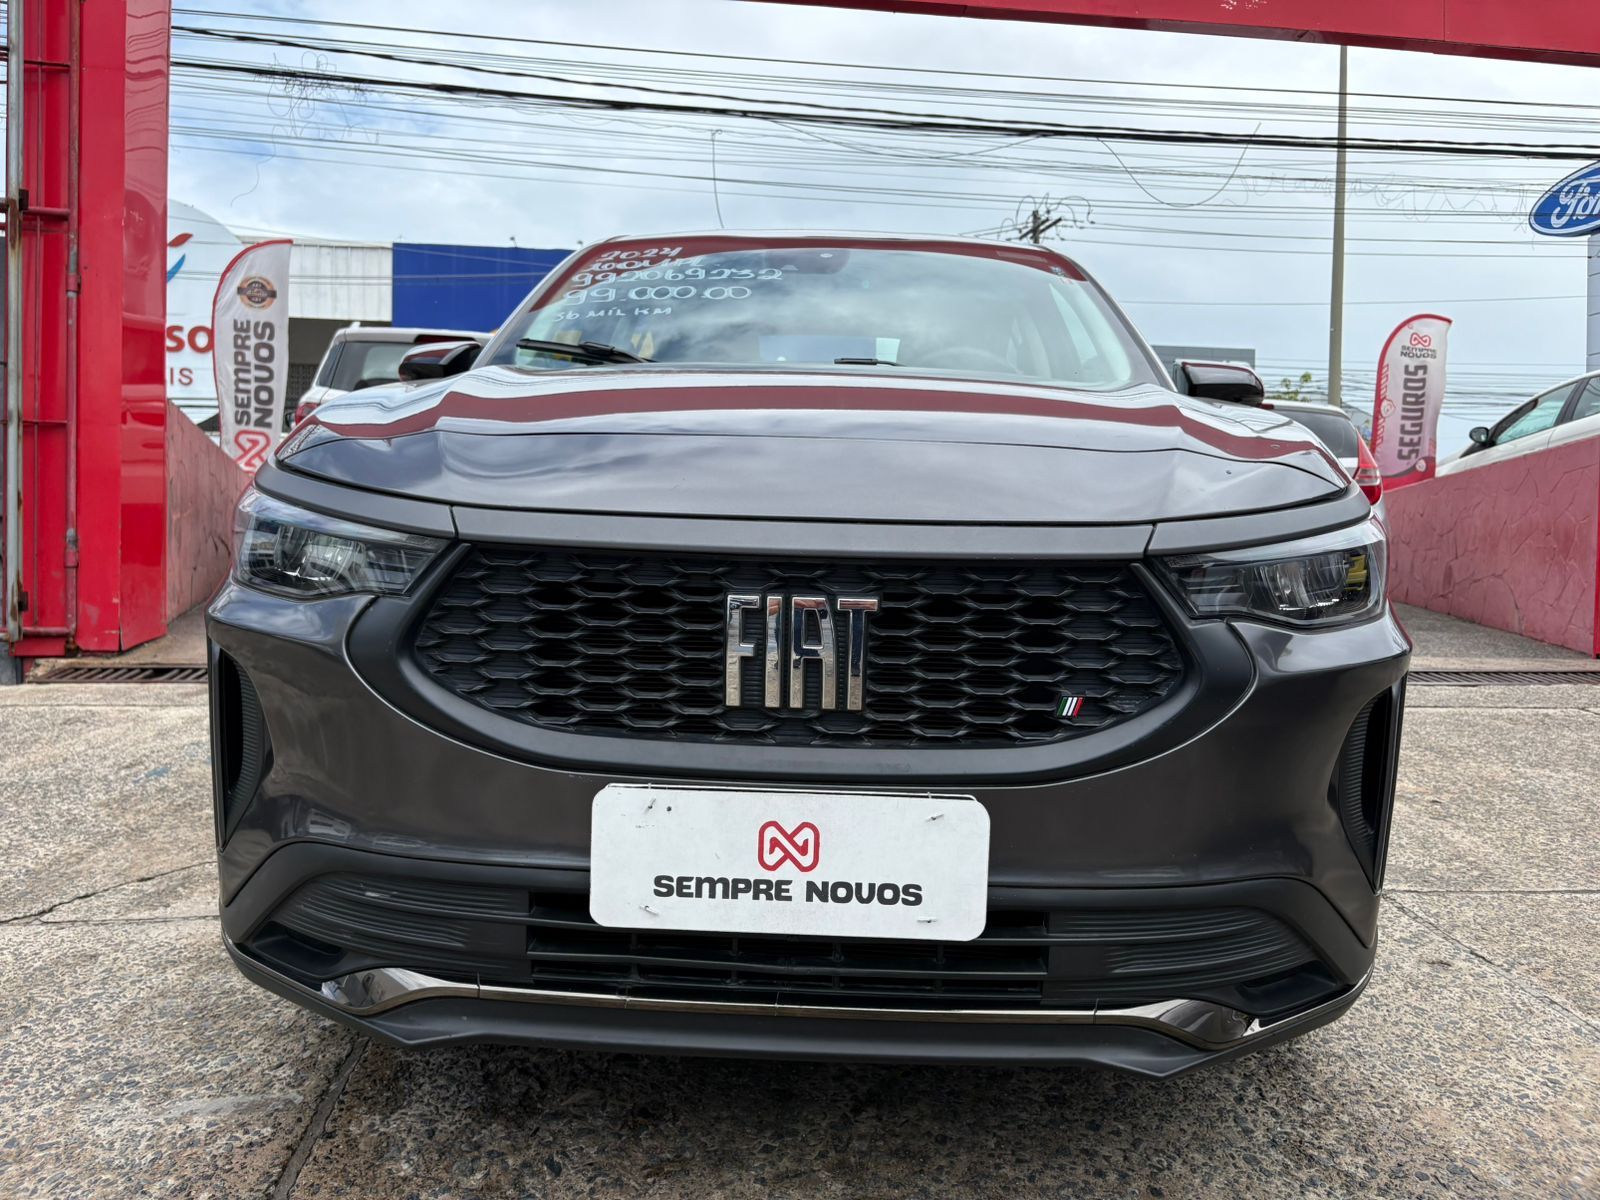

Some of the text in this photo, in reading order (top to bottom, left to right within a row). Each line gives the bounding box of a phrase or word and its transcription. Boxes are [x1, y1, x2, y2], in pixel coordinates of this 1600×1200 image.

[596, 247, 683, 261] 2024
[233, 319, 251, 427] SEMPRE
[1397, 364, 1428, 461] SEGUROS
[726, 594, 878, 710] FIAT
[653, 875, 793, 902] SEMPRE
